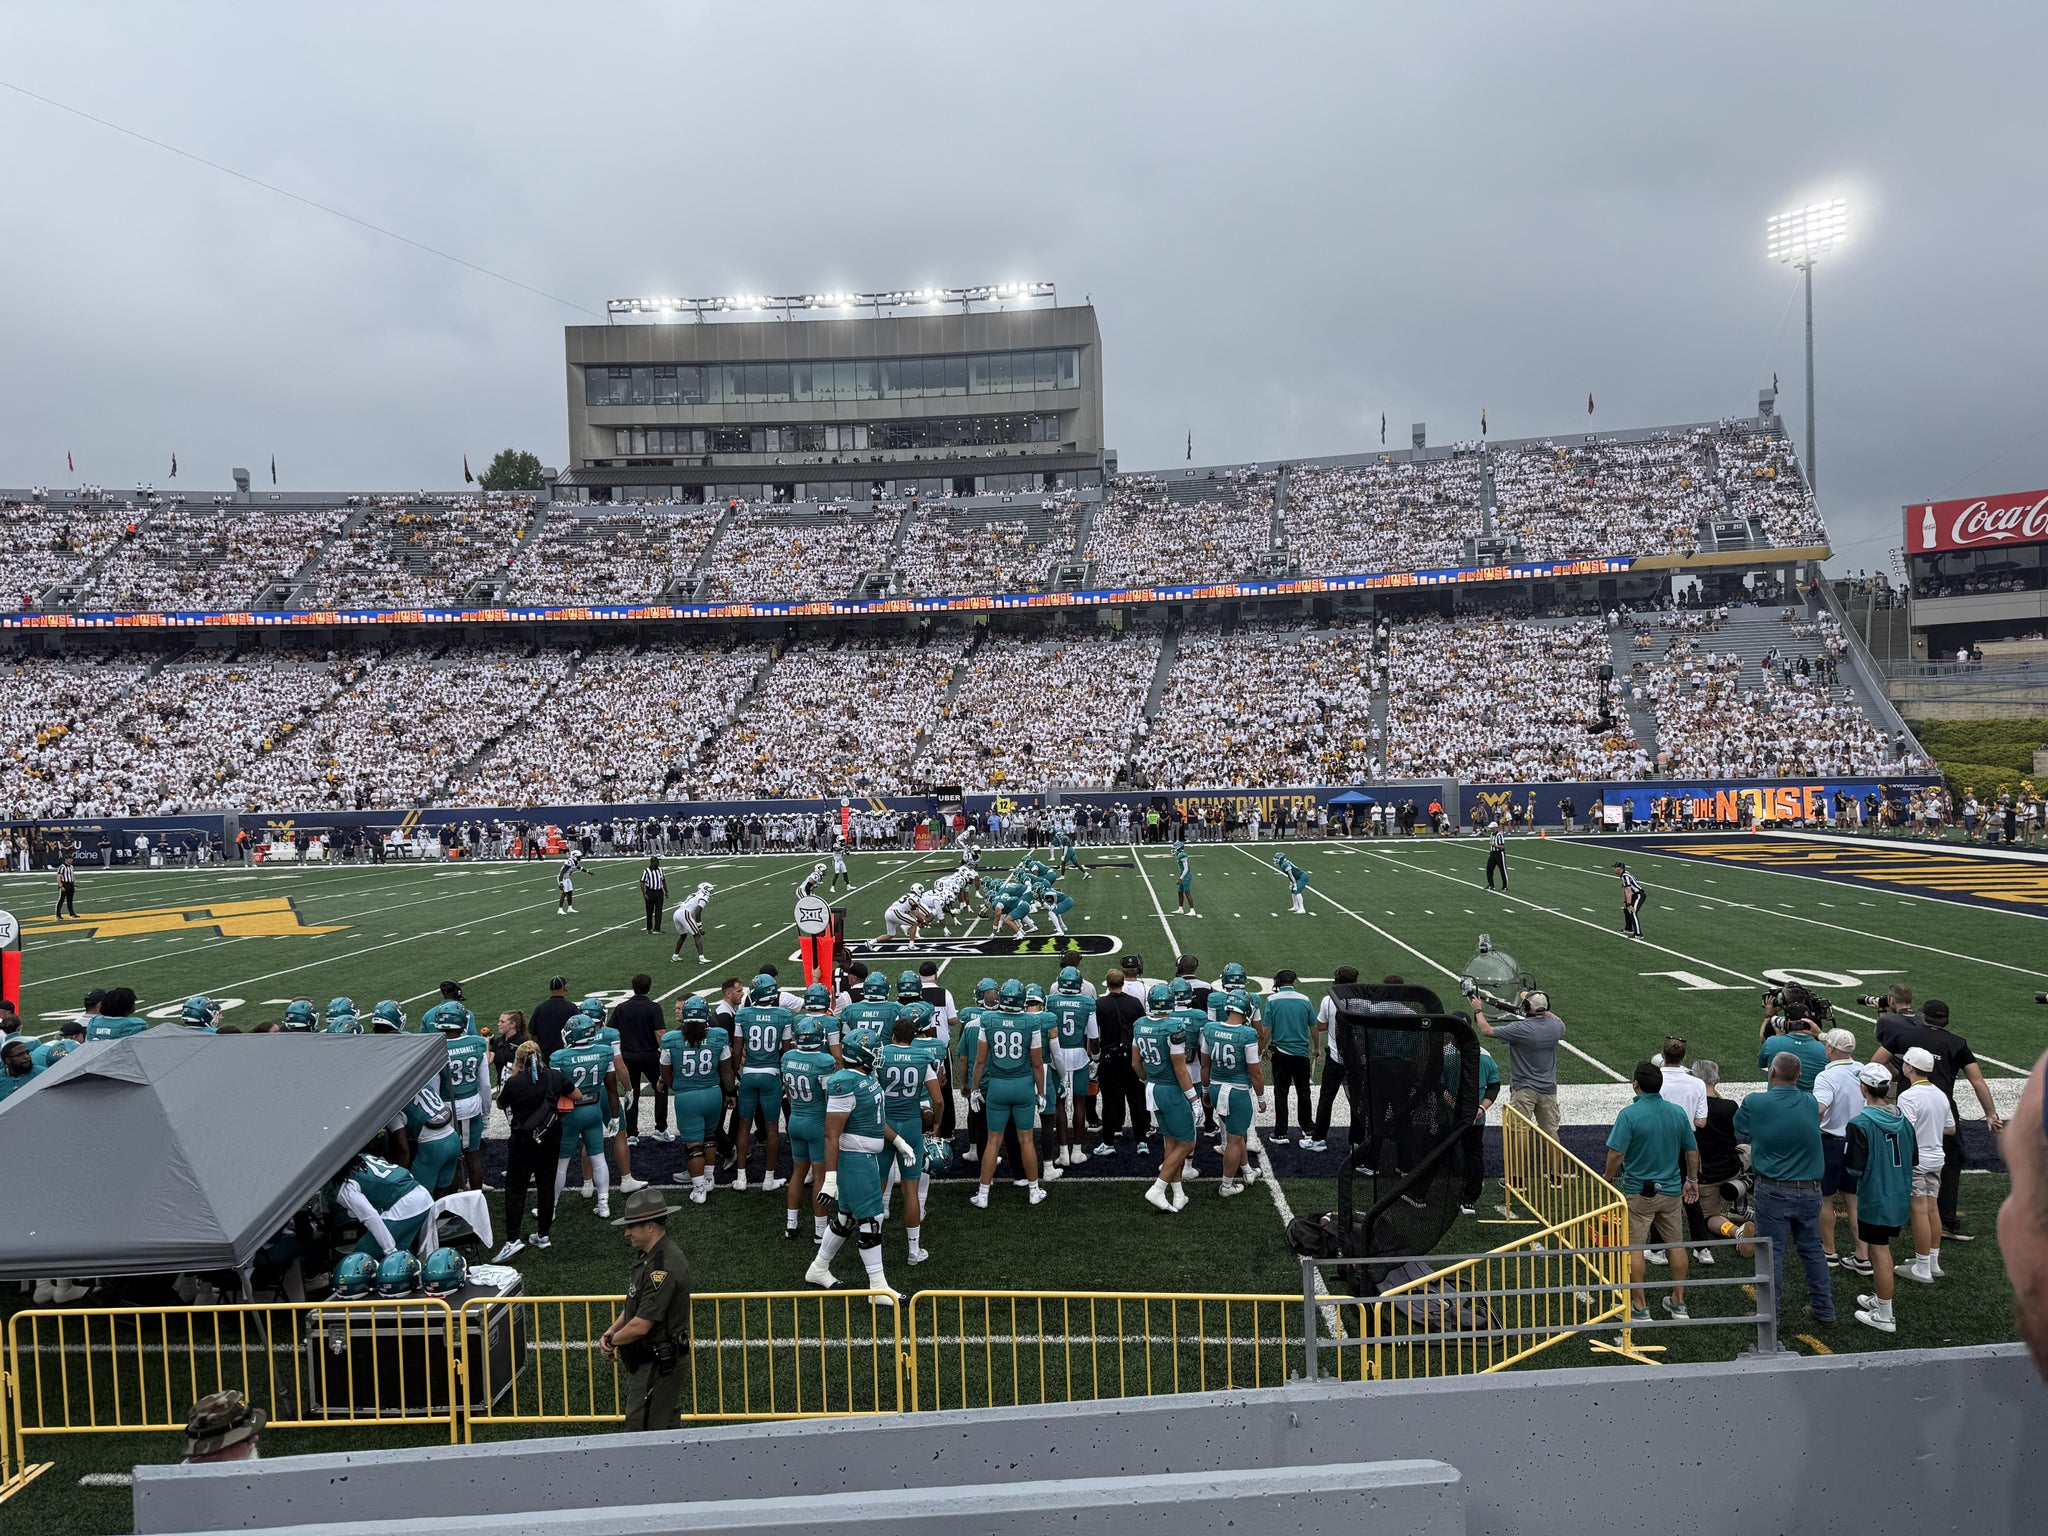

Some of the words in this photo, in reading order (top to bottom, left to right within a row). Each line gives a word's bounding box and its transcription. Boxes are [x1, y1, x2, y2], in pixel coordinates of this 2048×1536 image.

[1572, 559, 1606, 573] NOISE
[1476, 566, 1509, 579] NOISE
[1294, 579, 1325, 591] NOISE
[1383, 573, 1415, 585] NOISE
[1126, 589, 1154, 600] NOISE
[1208, 584, 1239, 596] NOISE
[964, 597, 992, 608] NOISE
[1044, 593, 1072, 604] NOISE
[644, 606, 672, 617] NOISE
[725, 604, 753, 615] NOISE
[804, 602, 832, 613] NOISE
[884, 600, 912, 611] NOISE
[222, 613, 252, 623] NOISE
[309, 612, 339, 623] NOISE
[393, 610, 423, 621] NOISE
[478, 609, 508, 620] NOISE
[561, 608, 590, 618] NOISE
[41, 615, 73, 625] NOISE
[132, 614, 164, 625] NOISE
[1000, 801, 1008, 809] 12
[1716, 786, 1825, 822] NOISE
[1062, 1011, 1075, 1037] 5
[748, 1025, 777, 1053] 80
[993, 1031, 1023, 1059] 88
[1137, 1037, 1161, 1065] 85
[1211, 1041, 1236, 1070] 46
[681, 1049, 714, 1077] 58
[449, 1056, 478, 1086] 33
[572, 1064, 599, 1088] 21
[785, 1072, 813, 1102] 30
[884, 1066, 919, 1097] 29
[413, 1088, 446, 1117] 10
[1885, 1132, 1902, 1168] 1
